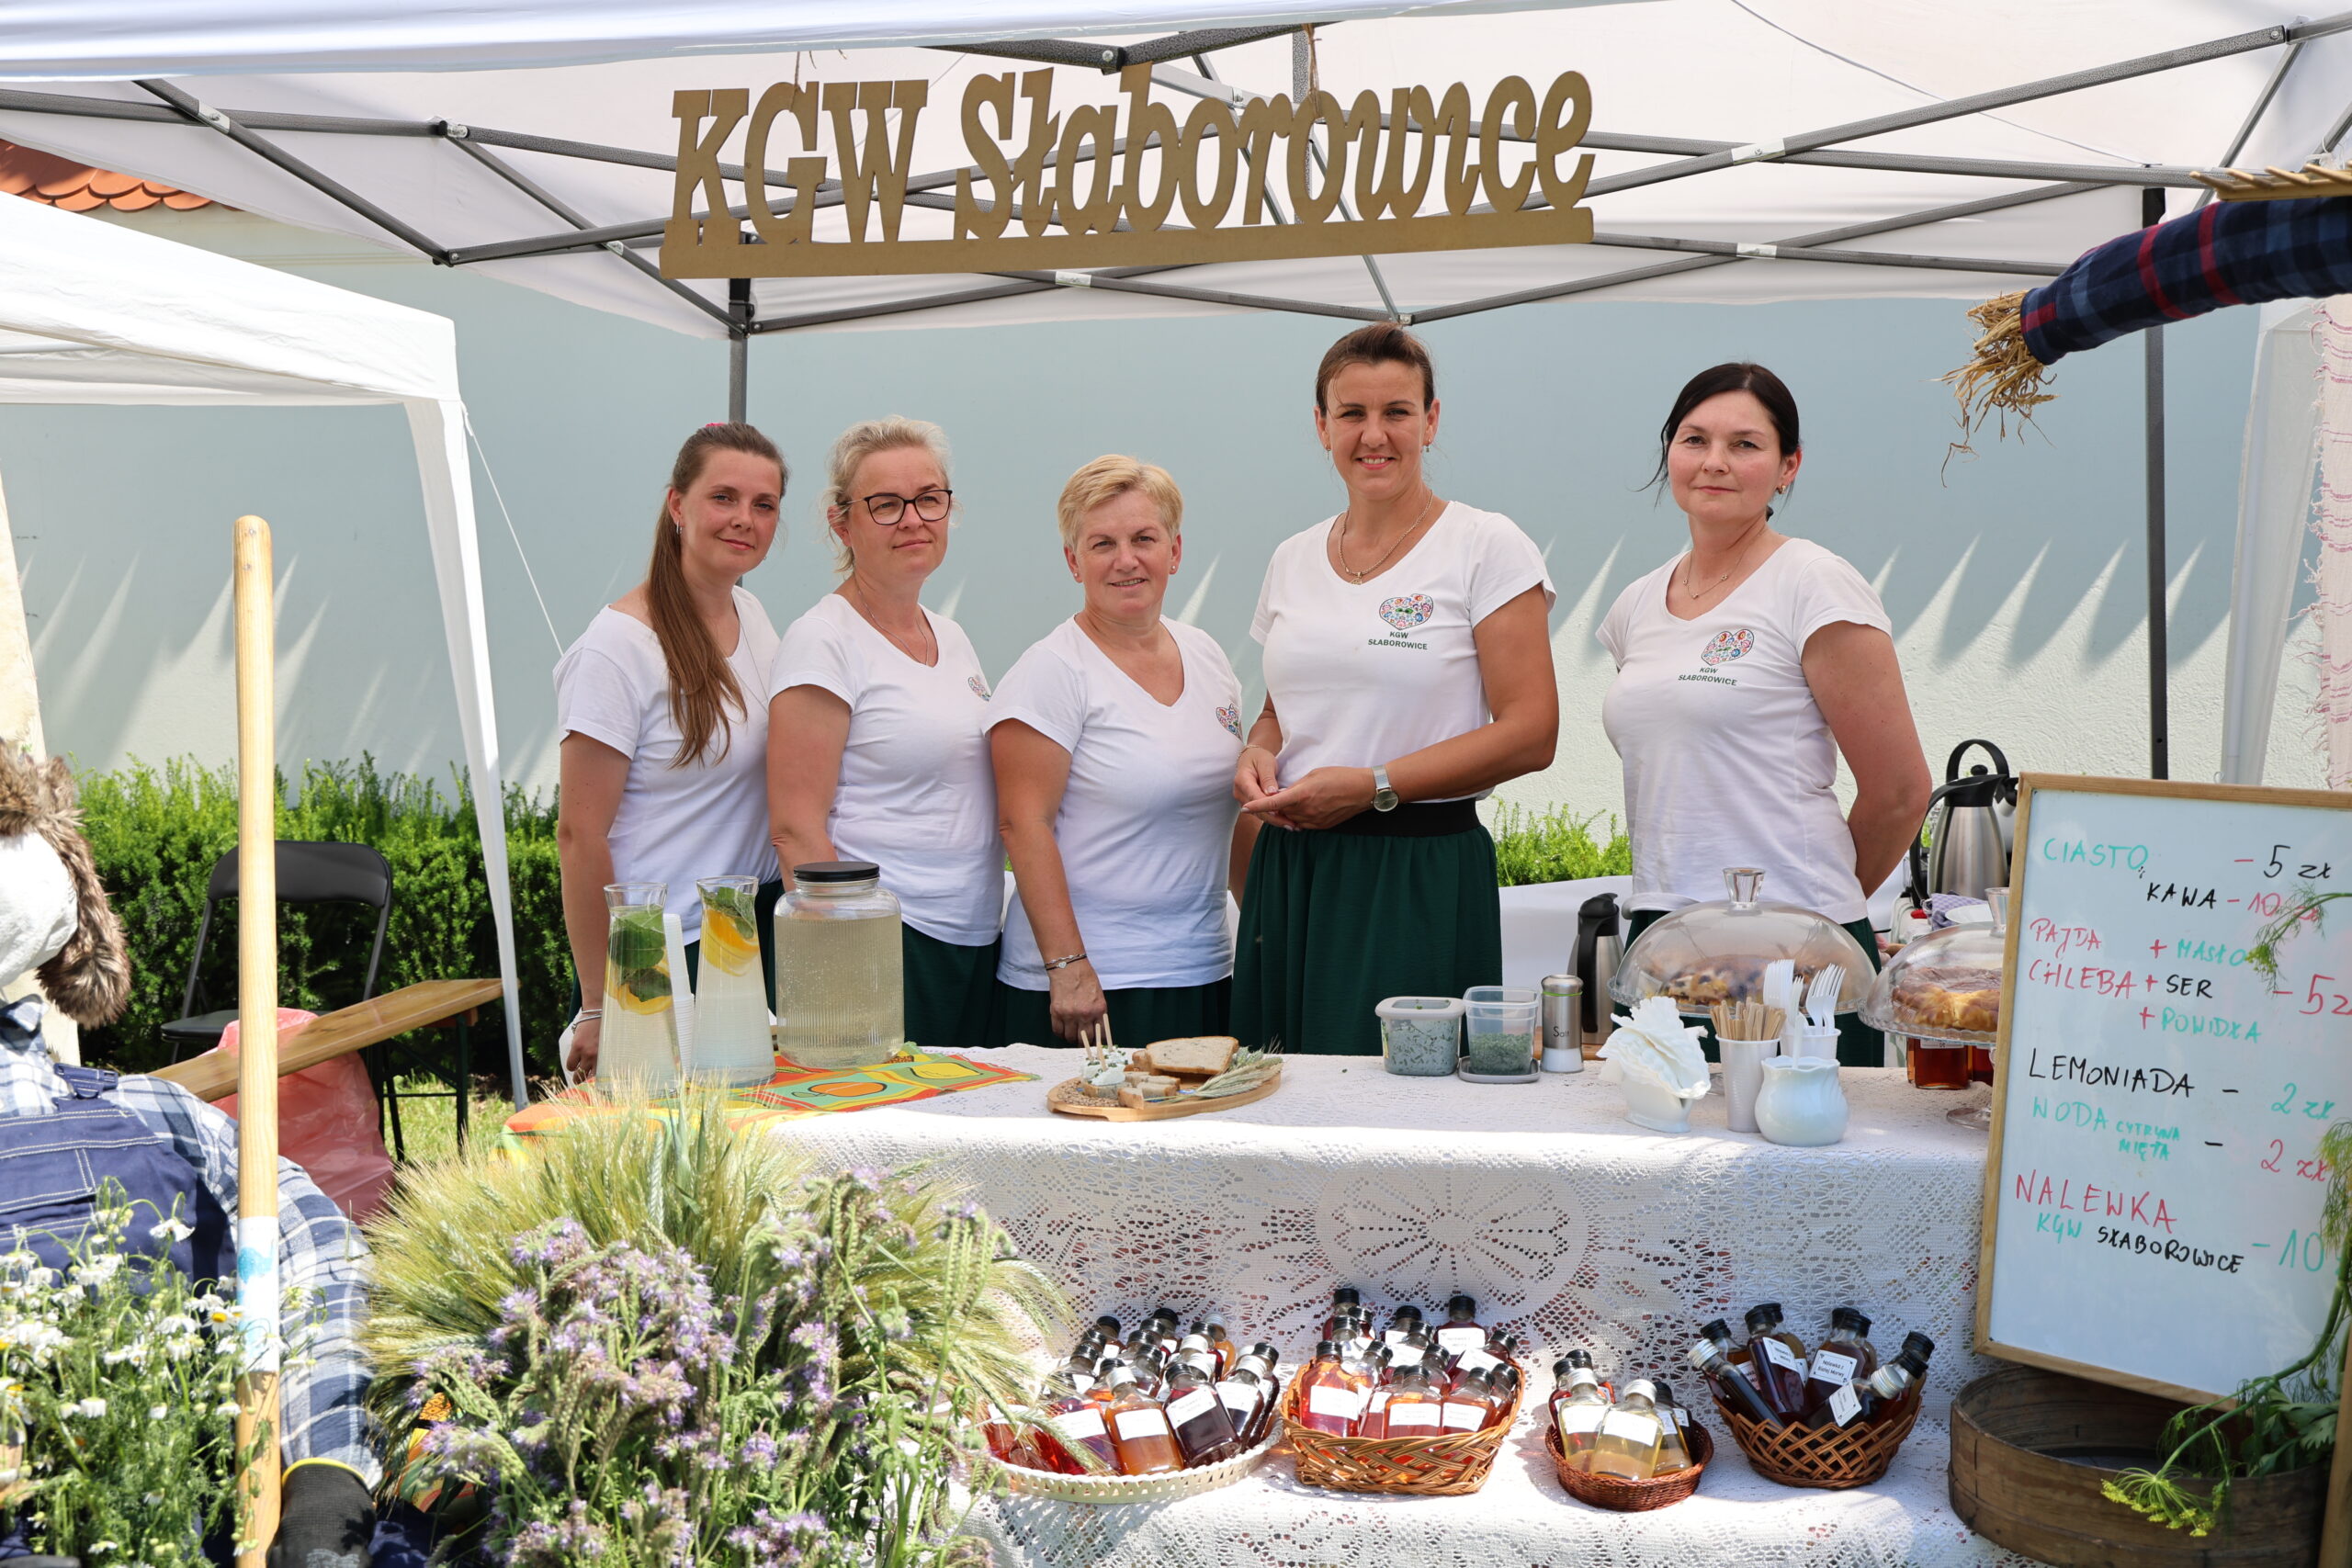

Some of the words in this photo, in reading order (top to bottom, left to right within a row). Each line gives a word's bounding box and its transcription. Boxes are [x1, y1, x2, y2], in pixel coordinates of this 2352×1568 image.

[665, 79, 929, 246] KGW
[1367, 638, 1428, 650] SŁABOROWICE
[1389, 631, 1409, 639] KGW
[1678, 674, 1738, 686] SŁABOROWICE
[2043, 838, 2149, 871] CIASTO
[2263, 844, 2291, 878] 5
[2297, 862, 2331, 879] zł
[2146, 883, 2217, 909] KAWA
[2247, 891, 2280, 917] 10
[2029, 918, 2102, 958] PAJDA
[2029, 959, 2137, 999] CHLEBA
[2166, 974, 2213, 998] SER
[2299, 974, 2335, 1015] 5
[1553, 1026, 1569, 1037] Salt
[2161, 1006, 2262, 1043] POWIDŁA
[2029, 1048, 2195, 1098] LEMONIADA
[2270, 1082, 2297, 1114] 2
[2301, 1100, 2335, 1120] zł
[2032, 1096, 2109, 1132] WODA
[2116, 1120, 2180, 1141] CYTRYNA
[2118, 1138, 2169, 1161] MIĘTA
[2260, 1138, 2283, 1173] 2
[2015, 1168, 2177, 1234] NALEWKA
[2036, 1213, 2082, 1244] KGW
[2098, 1226, 2245, 1273] SŁABOROWICE
[2278, 1229, 2324, 1272] 10
